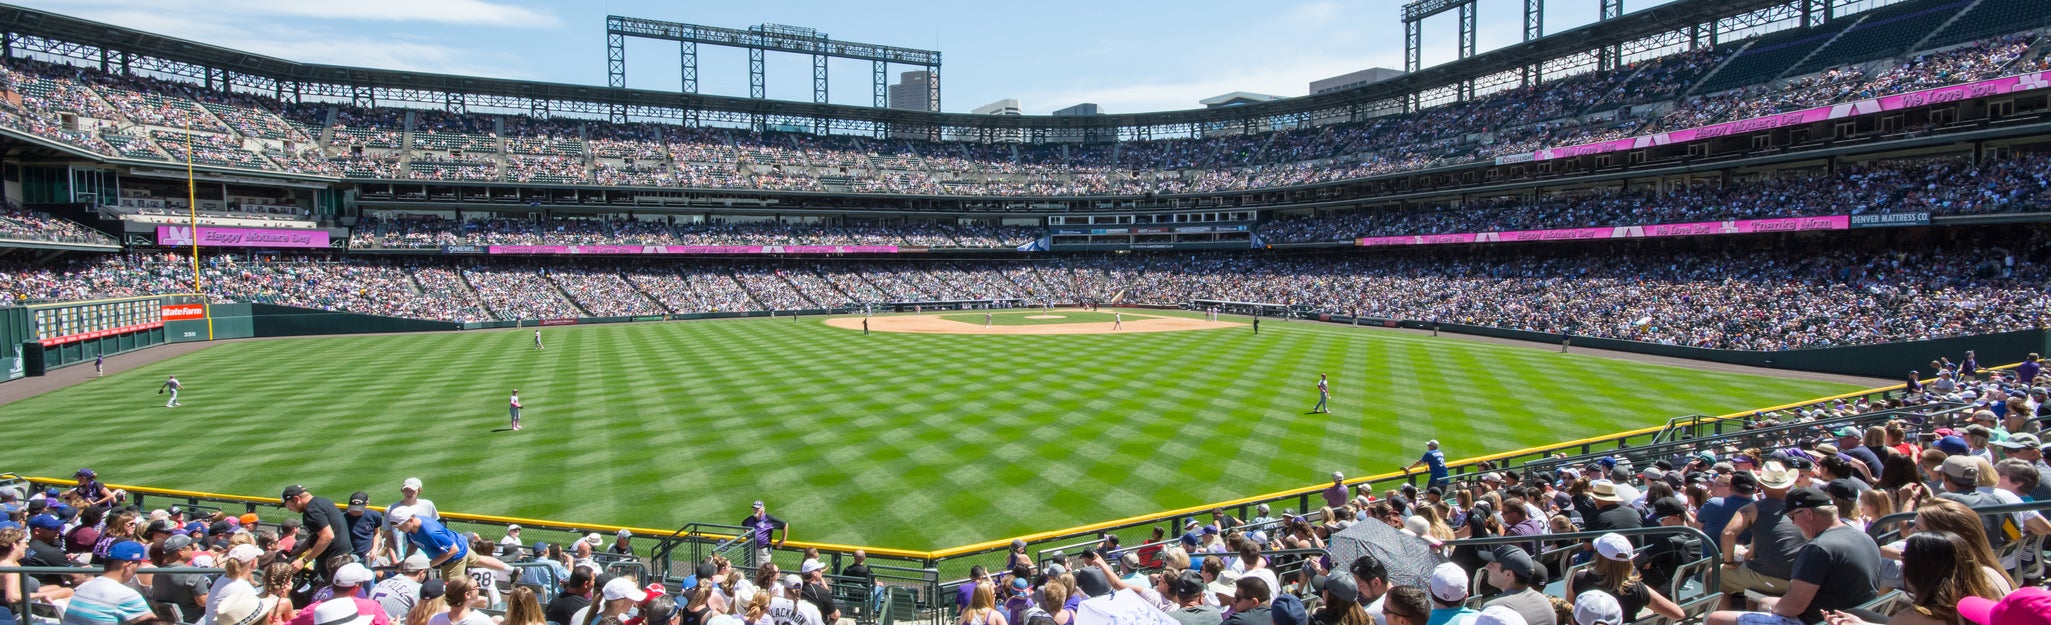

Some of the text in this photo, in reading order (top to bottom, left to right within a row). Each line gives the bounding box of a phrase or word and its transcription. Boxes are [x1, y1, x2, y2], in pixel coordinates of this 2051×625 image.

[1902, 83, 1997, 107] We Love You
[1695, 126, 1727, 140] Happy
[1780, 114, 1804, 127] Day
[1751, 218, 1832, 232] Thanks Mom
[1852, 214, 1879, 224] DENVER
[1882, 213, 1916, 223] MATTRESS
[1917, 212, 1929, 220] CO.
[1517, 231, 1540, 240] Happy
[1579, 228, 1595, 238] Day
[1670, 226, 1691, 235] Love
[1694, 224, 1710, 234] You
[205, 231, 242, 243] Happy
[291, 233, 312, 245] Day
